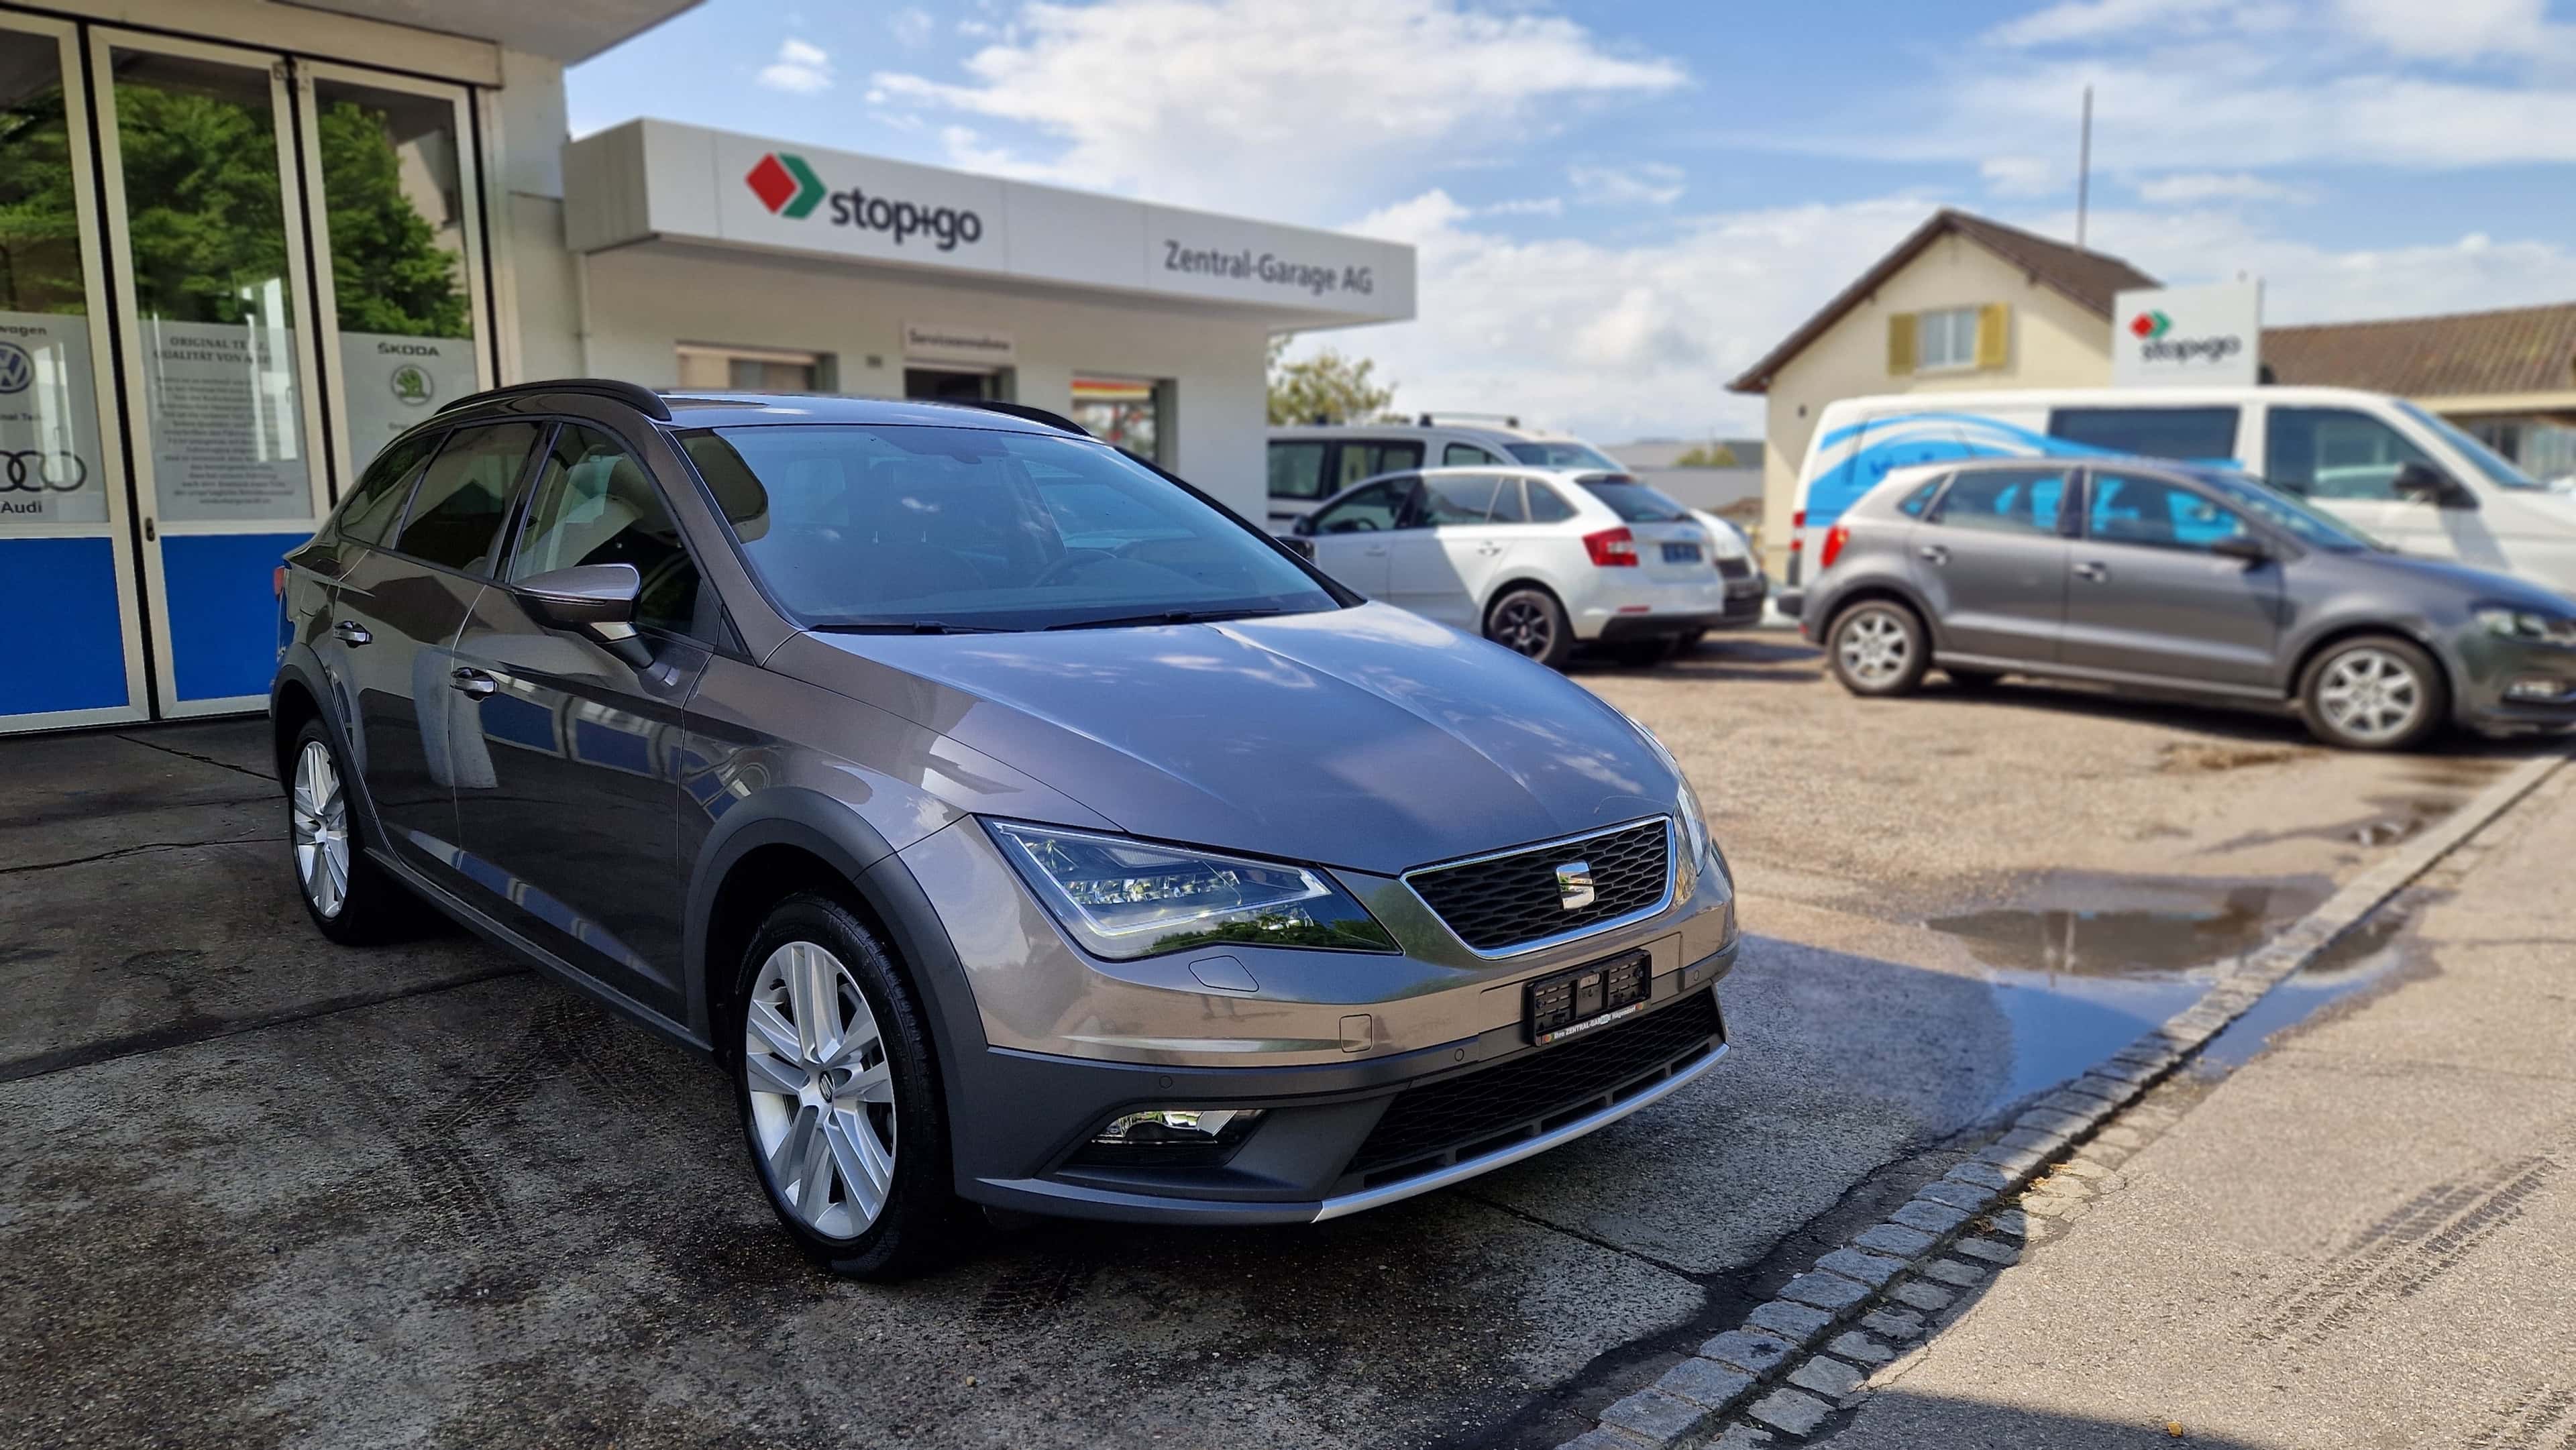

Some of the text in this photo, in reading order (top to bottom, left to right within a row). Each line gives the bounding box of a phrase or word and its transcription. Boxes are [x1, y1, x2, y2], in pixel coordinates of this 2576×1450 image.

[830, 187, 982, 252] stop+go
[1163, 239, 1373, 296] Zentral-Garage AG
[1, 500, 43, 513] Audi
